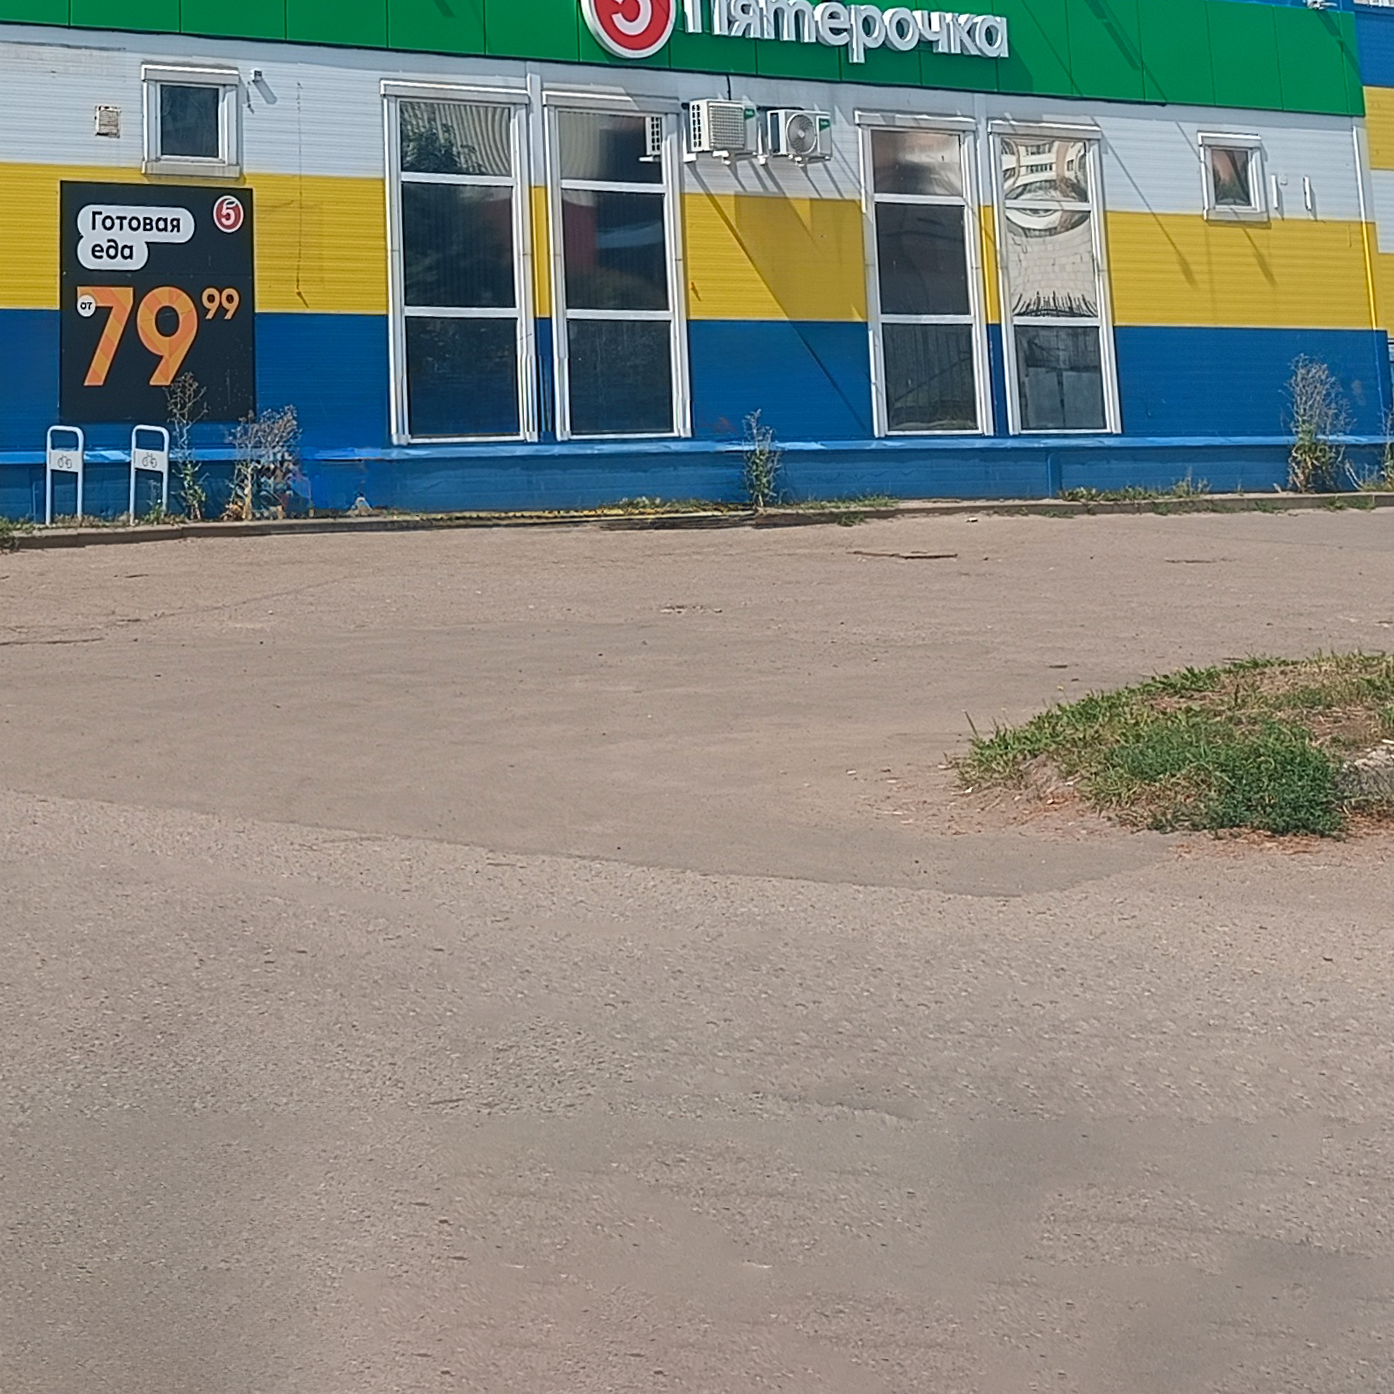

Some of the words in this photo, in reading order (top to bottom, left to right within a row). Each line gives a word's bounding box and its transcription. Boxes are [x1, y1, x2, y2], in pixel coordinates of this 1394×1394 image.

[91, 211, 181, 233] Готовая
[91, 239, 134, 260] еда
[80, 301, 93, 310] от
[202, 287, 240, 320] 99
[77, 286, 198, 386] 79
